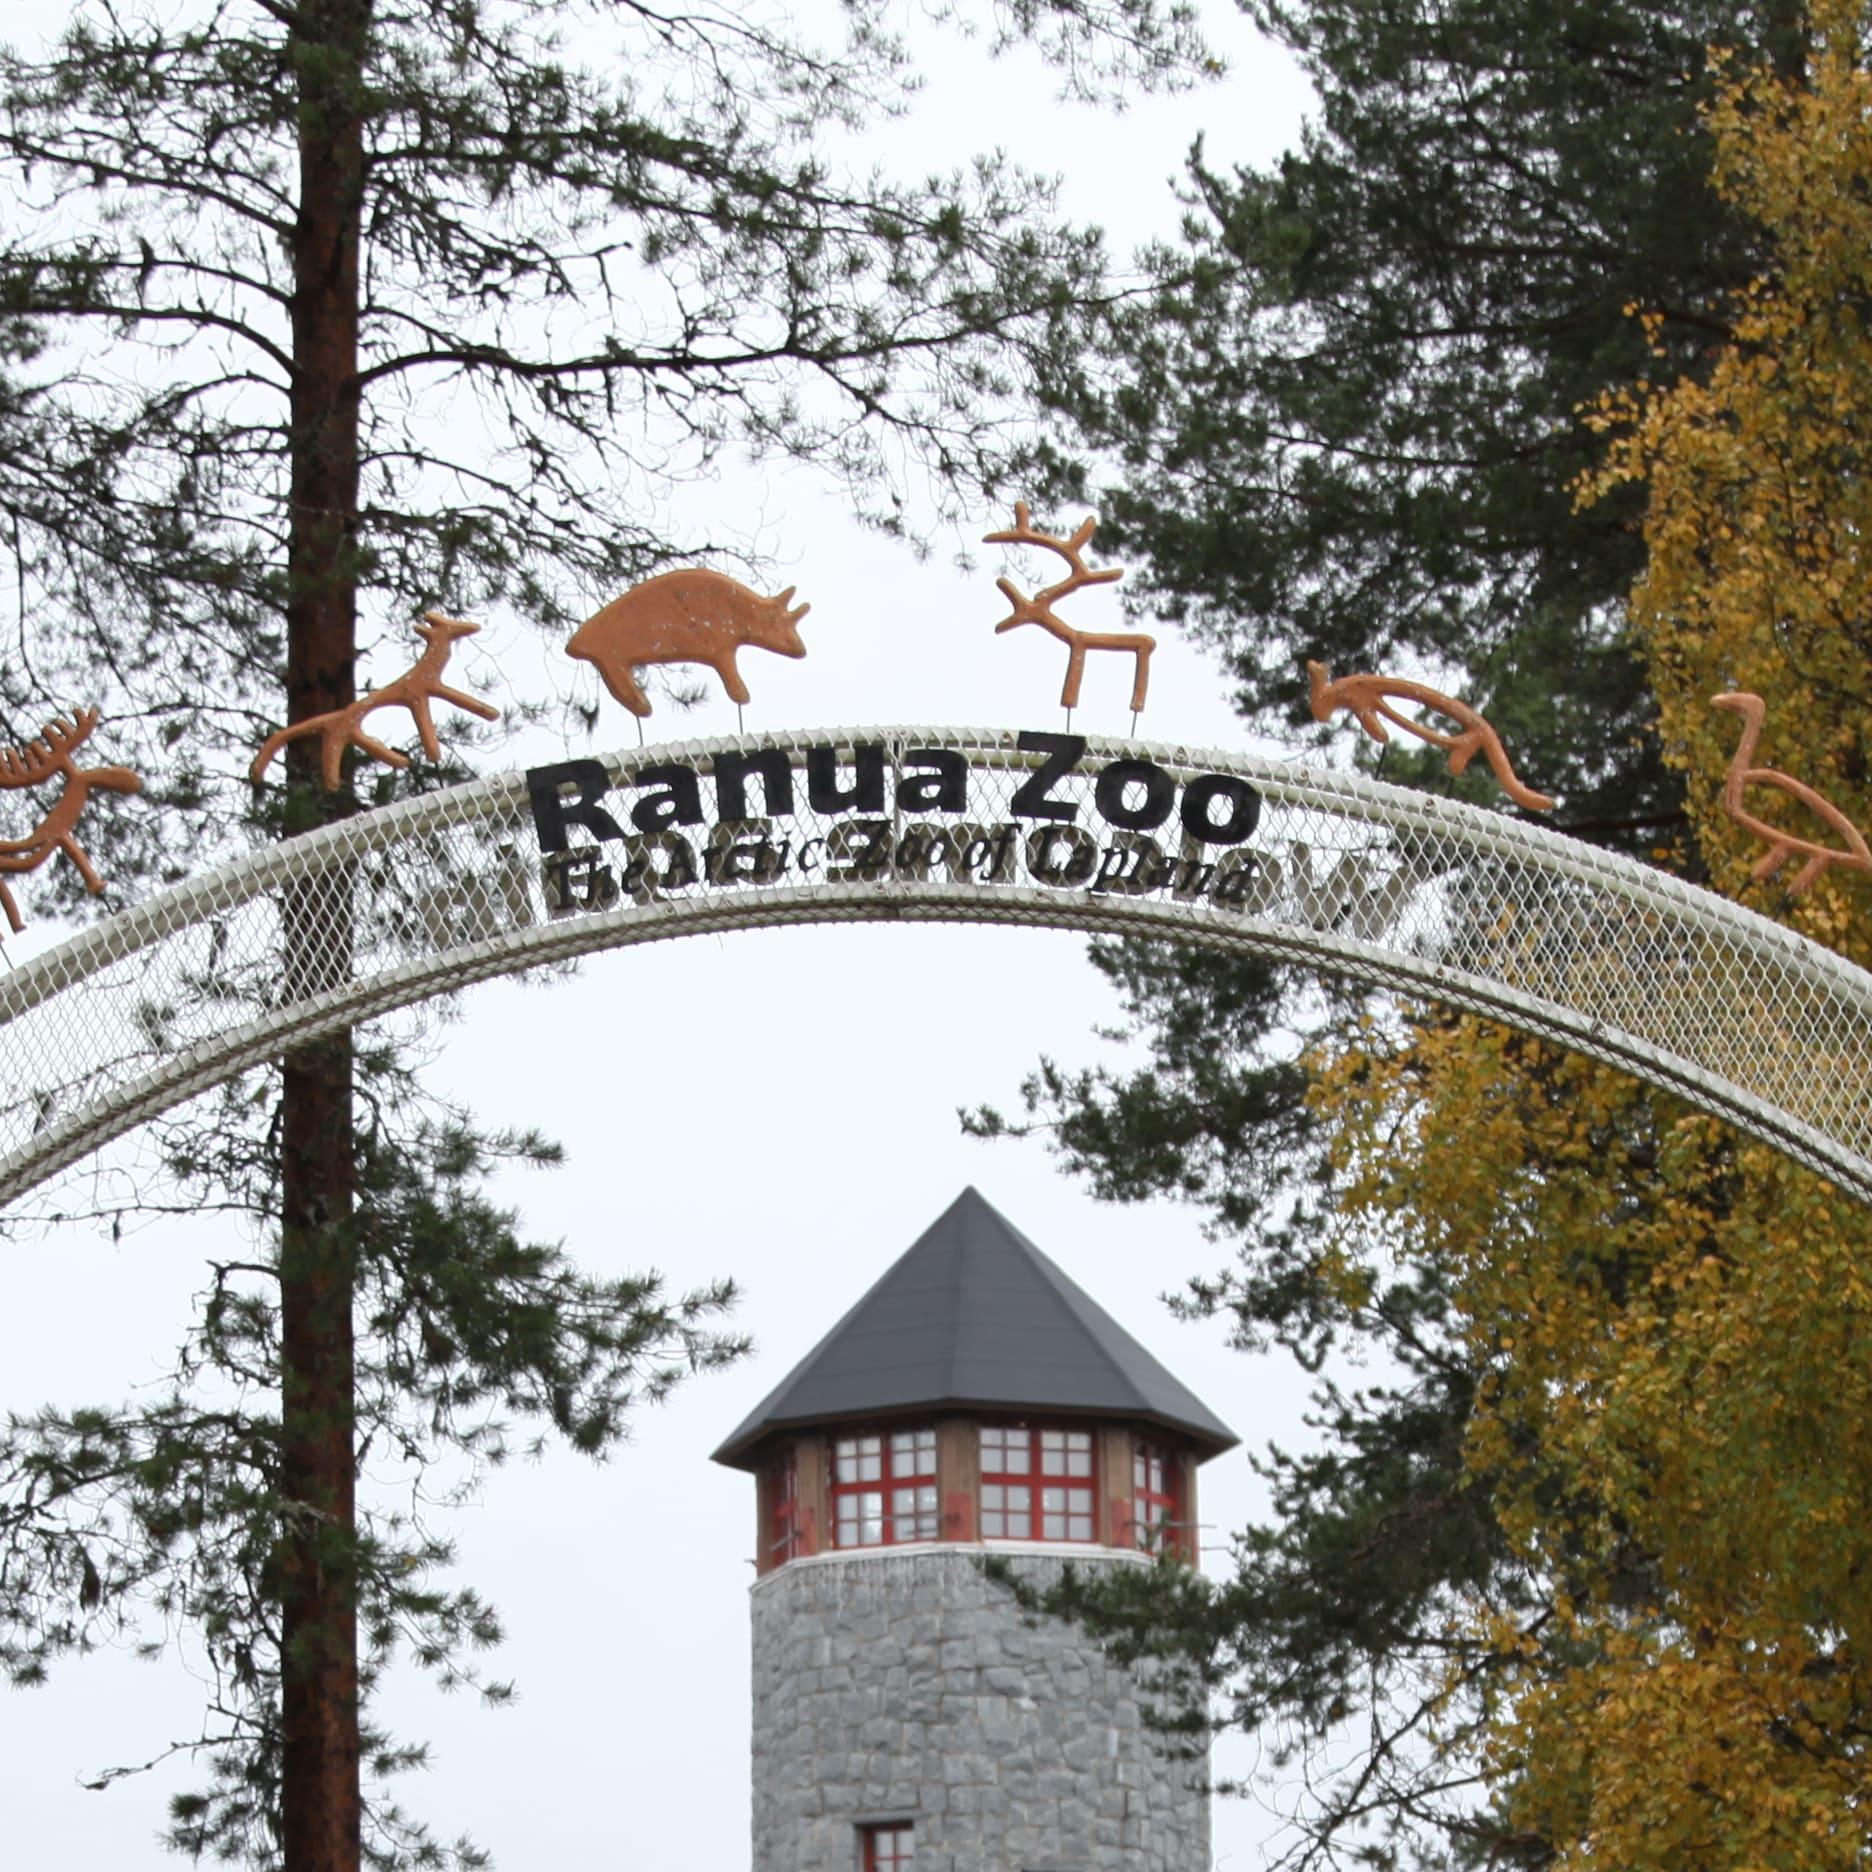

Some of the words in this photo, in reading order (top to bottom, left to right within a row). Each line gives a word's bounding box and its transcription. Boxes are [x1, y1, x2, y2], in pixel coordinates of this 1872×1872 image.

[528, 741, 968, 853] Ranua
[1012, 730, 1259, 845] Zoo
[548, 850, 642, 908] The
[658, 832, 826, 889] Arctic
[850, 820, 952, 869] Zoo
[962, 823, 1022, 881] of
[1034, 826, 1259, 908] Lapland
